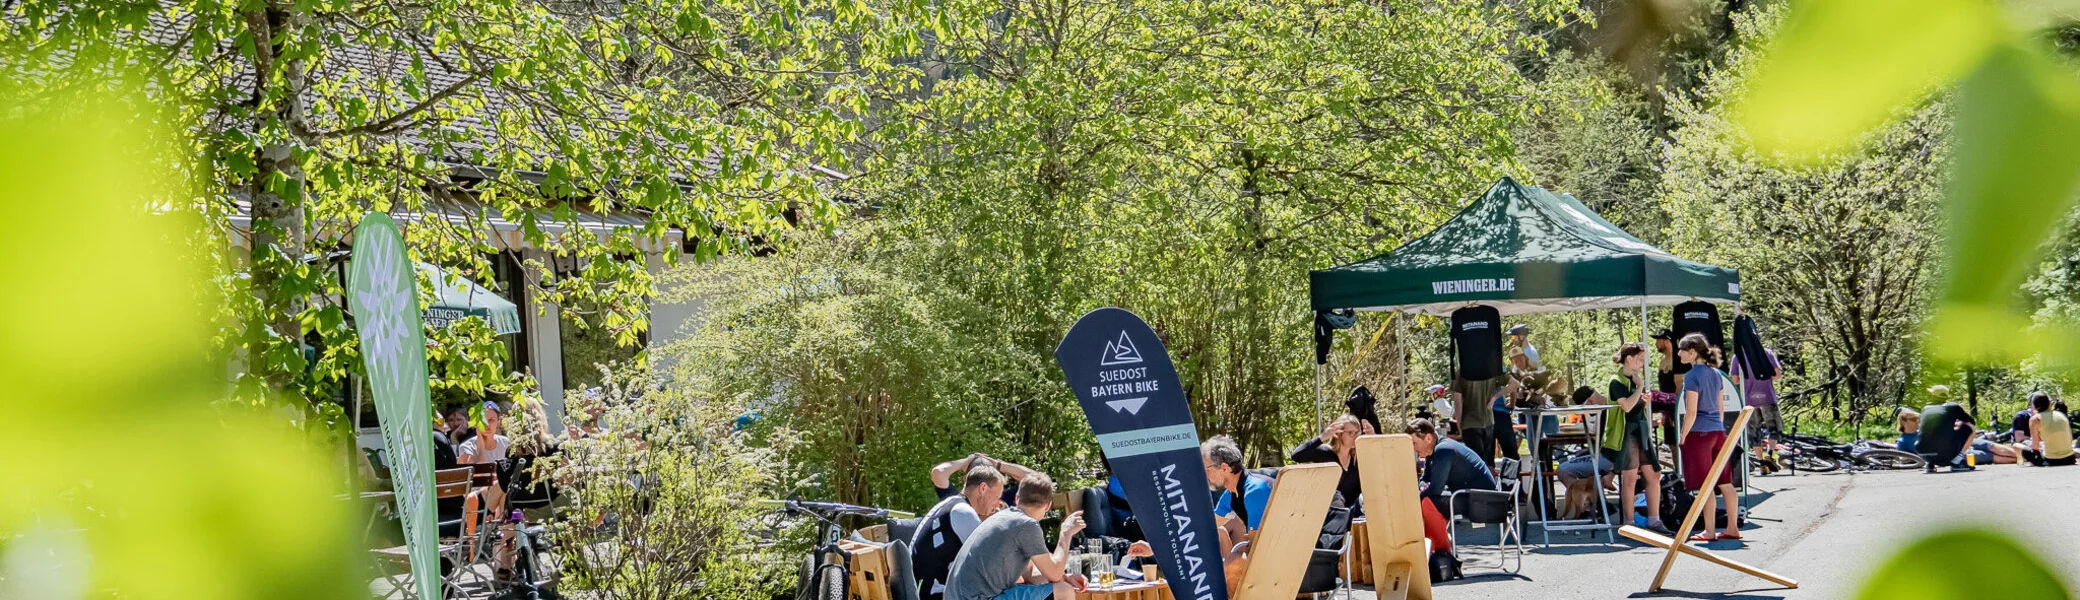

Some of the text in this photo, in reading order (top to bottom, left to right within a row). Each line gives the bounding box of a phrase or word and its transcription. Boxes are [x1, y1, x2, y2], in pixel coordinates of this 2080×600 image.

[1432, 278, 1515, 295] WIENINGER.DE
[1099, 367, 1147, 382] SUEDOST
[1091, 380, 1159, 398] BAYERN BIKE
[1111, 432, 1192, 449] SUEDOSTBAYERNBIKE.DE
[1151, 470, 1172, 528] RESPEKTVOLL
[1170, 538, 1186, 581] TOLERANT
